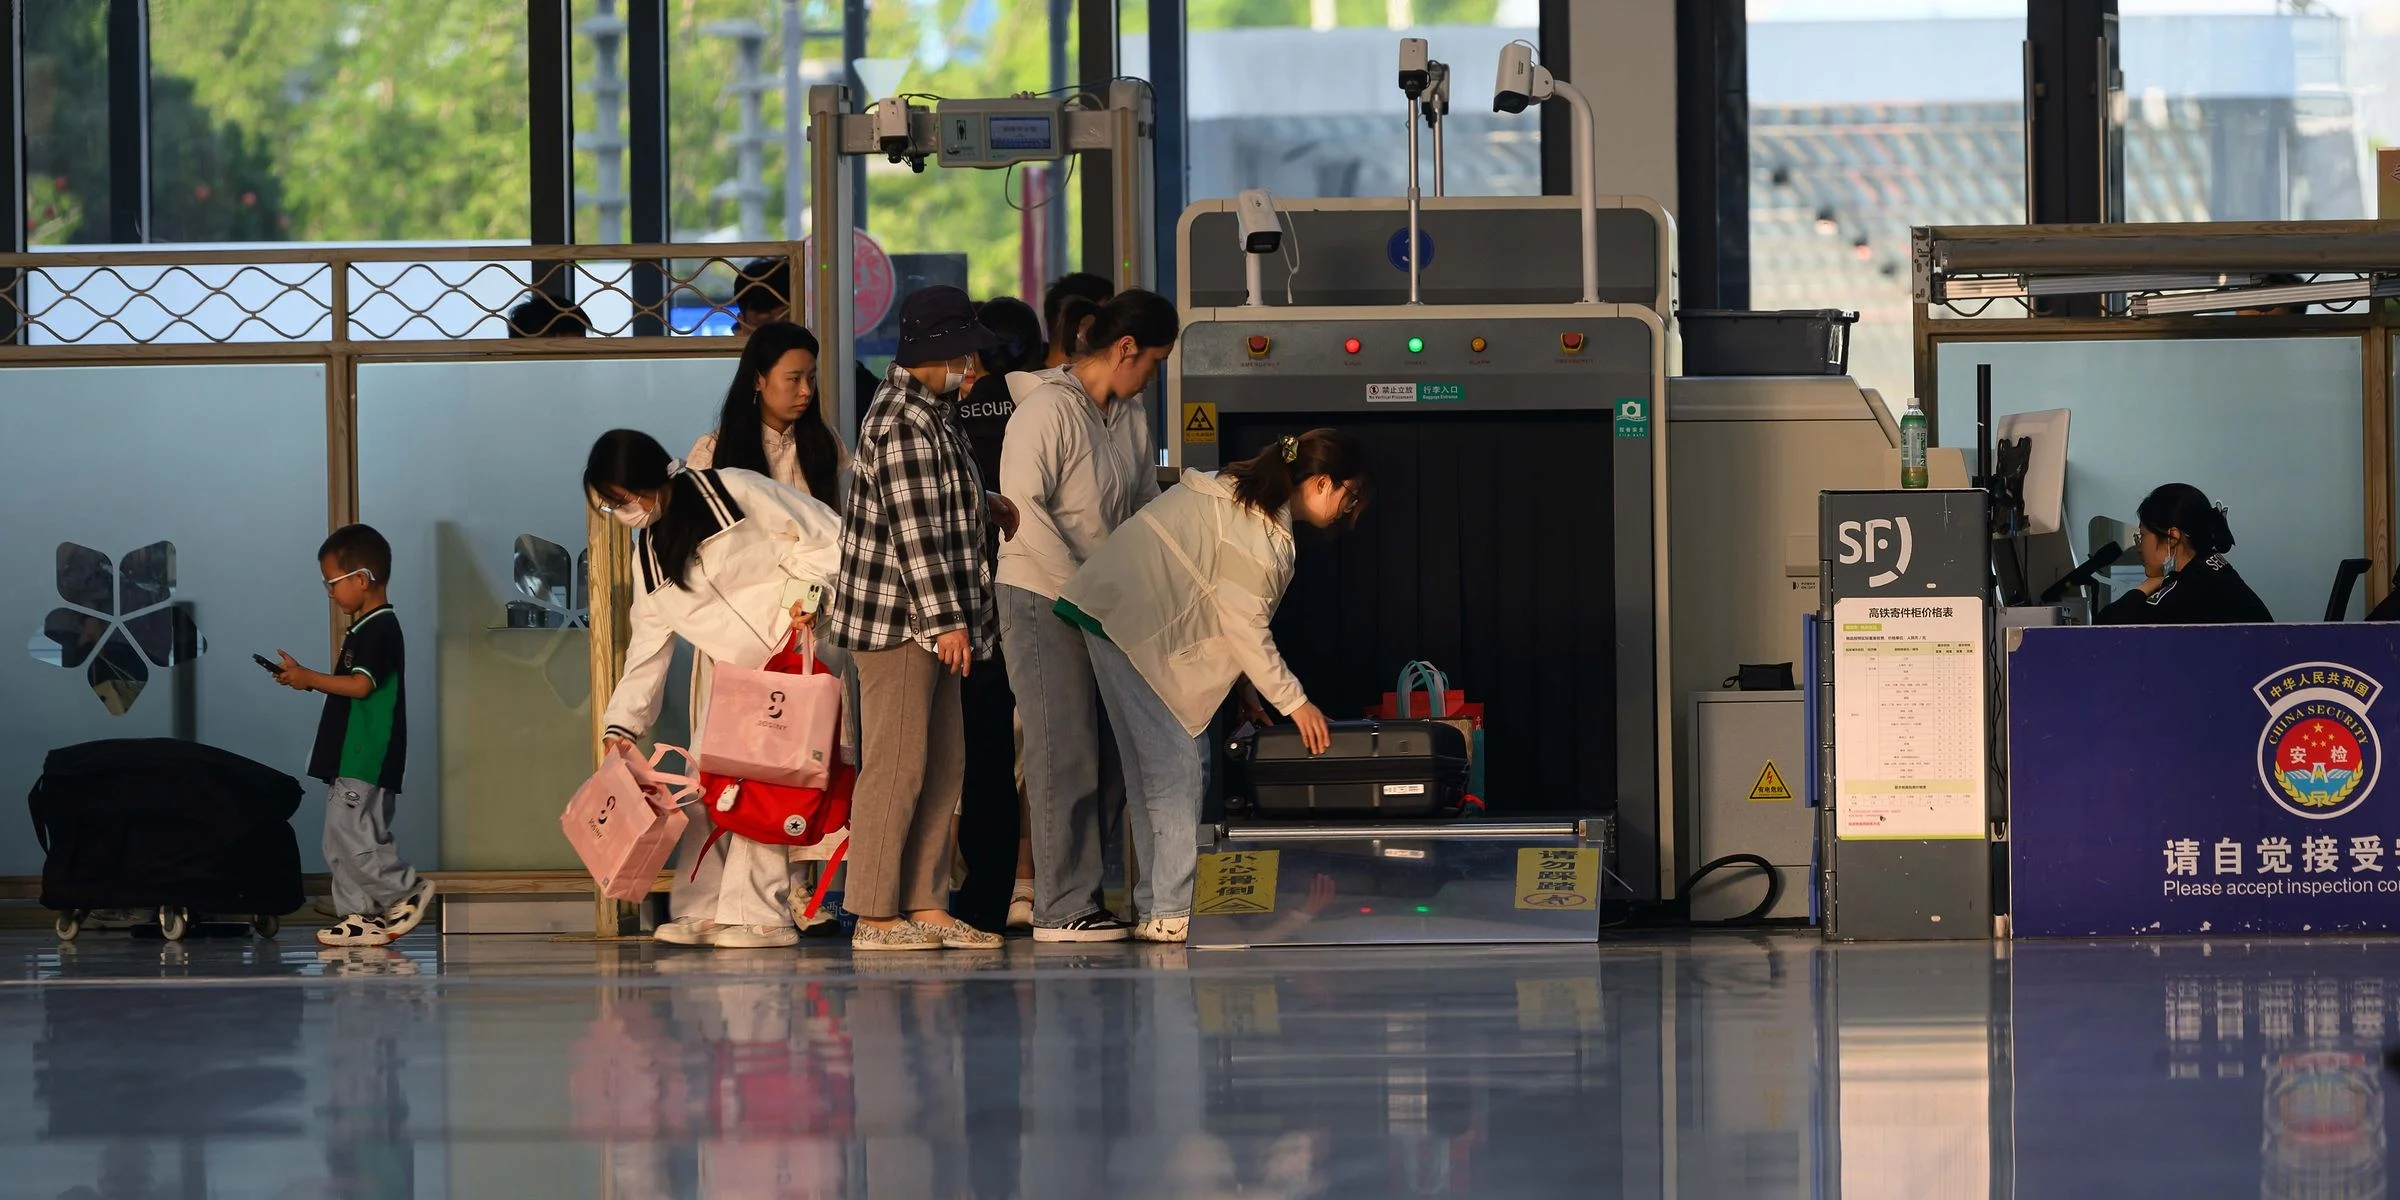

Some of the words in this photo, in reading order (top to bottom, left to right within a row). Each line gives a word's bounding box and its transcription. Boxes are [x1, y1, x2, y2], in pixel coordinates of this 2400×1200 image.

[1423, 385, 1458, 394] 行李入口
[1868, 607, 1953, 618] 高铁寄件柜价格表
[2270, 671, 2370, 698] 中华人民共和国
[2268, 708, 2305, 745] CHINA
[2307, 704, 2369, 745] SECURITY
[2289, 746, 2348, 764] 安检
[1217, 853, 1258, 897] 小心滑倒
[2164, 880, 2222, 896] Please
[2226, 880, 2283, 898] accept
[2287, 877, 2373, 897] inspection
[2378, 880, 2400, 892] co
